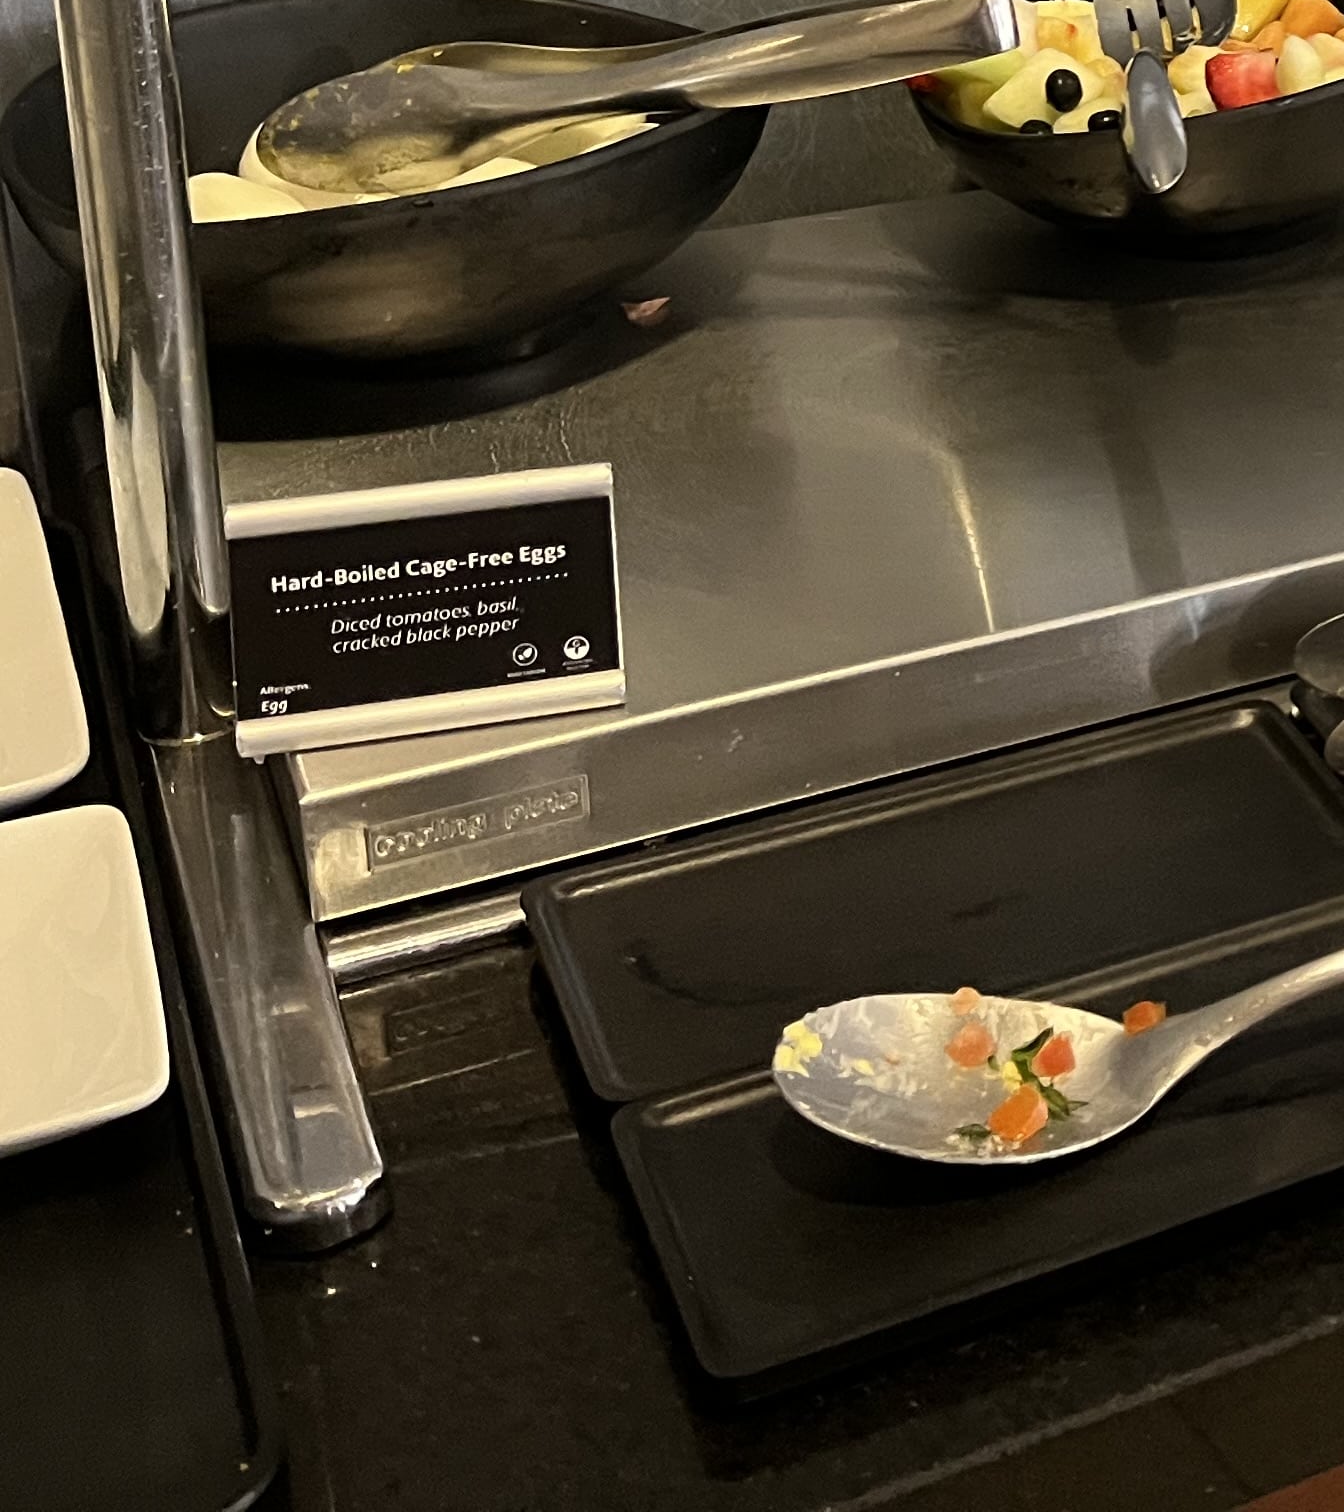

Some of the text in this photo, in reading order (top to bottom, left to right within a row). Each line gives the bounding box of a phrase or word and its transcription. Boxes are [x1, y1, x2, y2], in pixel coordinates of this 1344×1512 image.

[271, 544, 567, 593] Hard-Boiled Cage-Free Eggs
[331, 612, 381, 634] Diced
[332, 618, 520, 654] cracked black pepper
[260, 699, 288, 714] Egg
[375, 813, 487, 857] cooling
